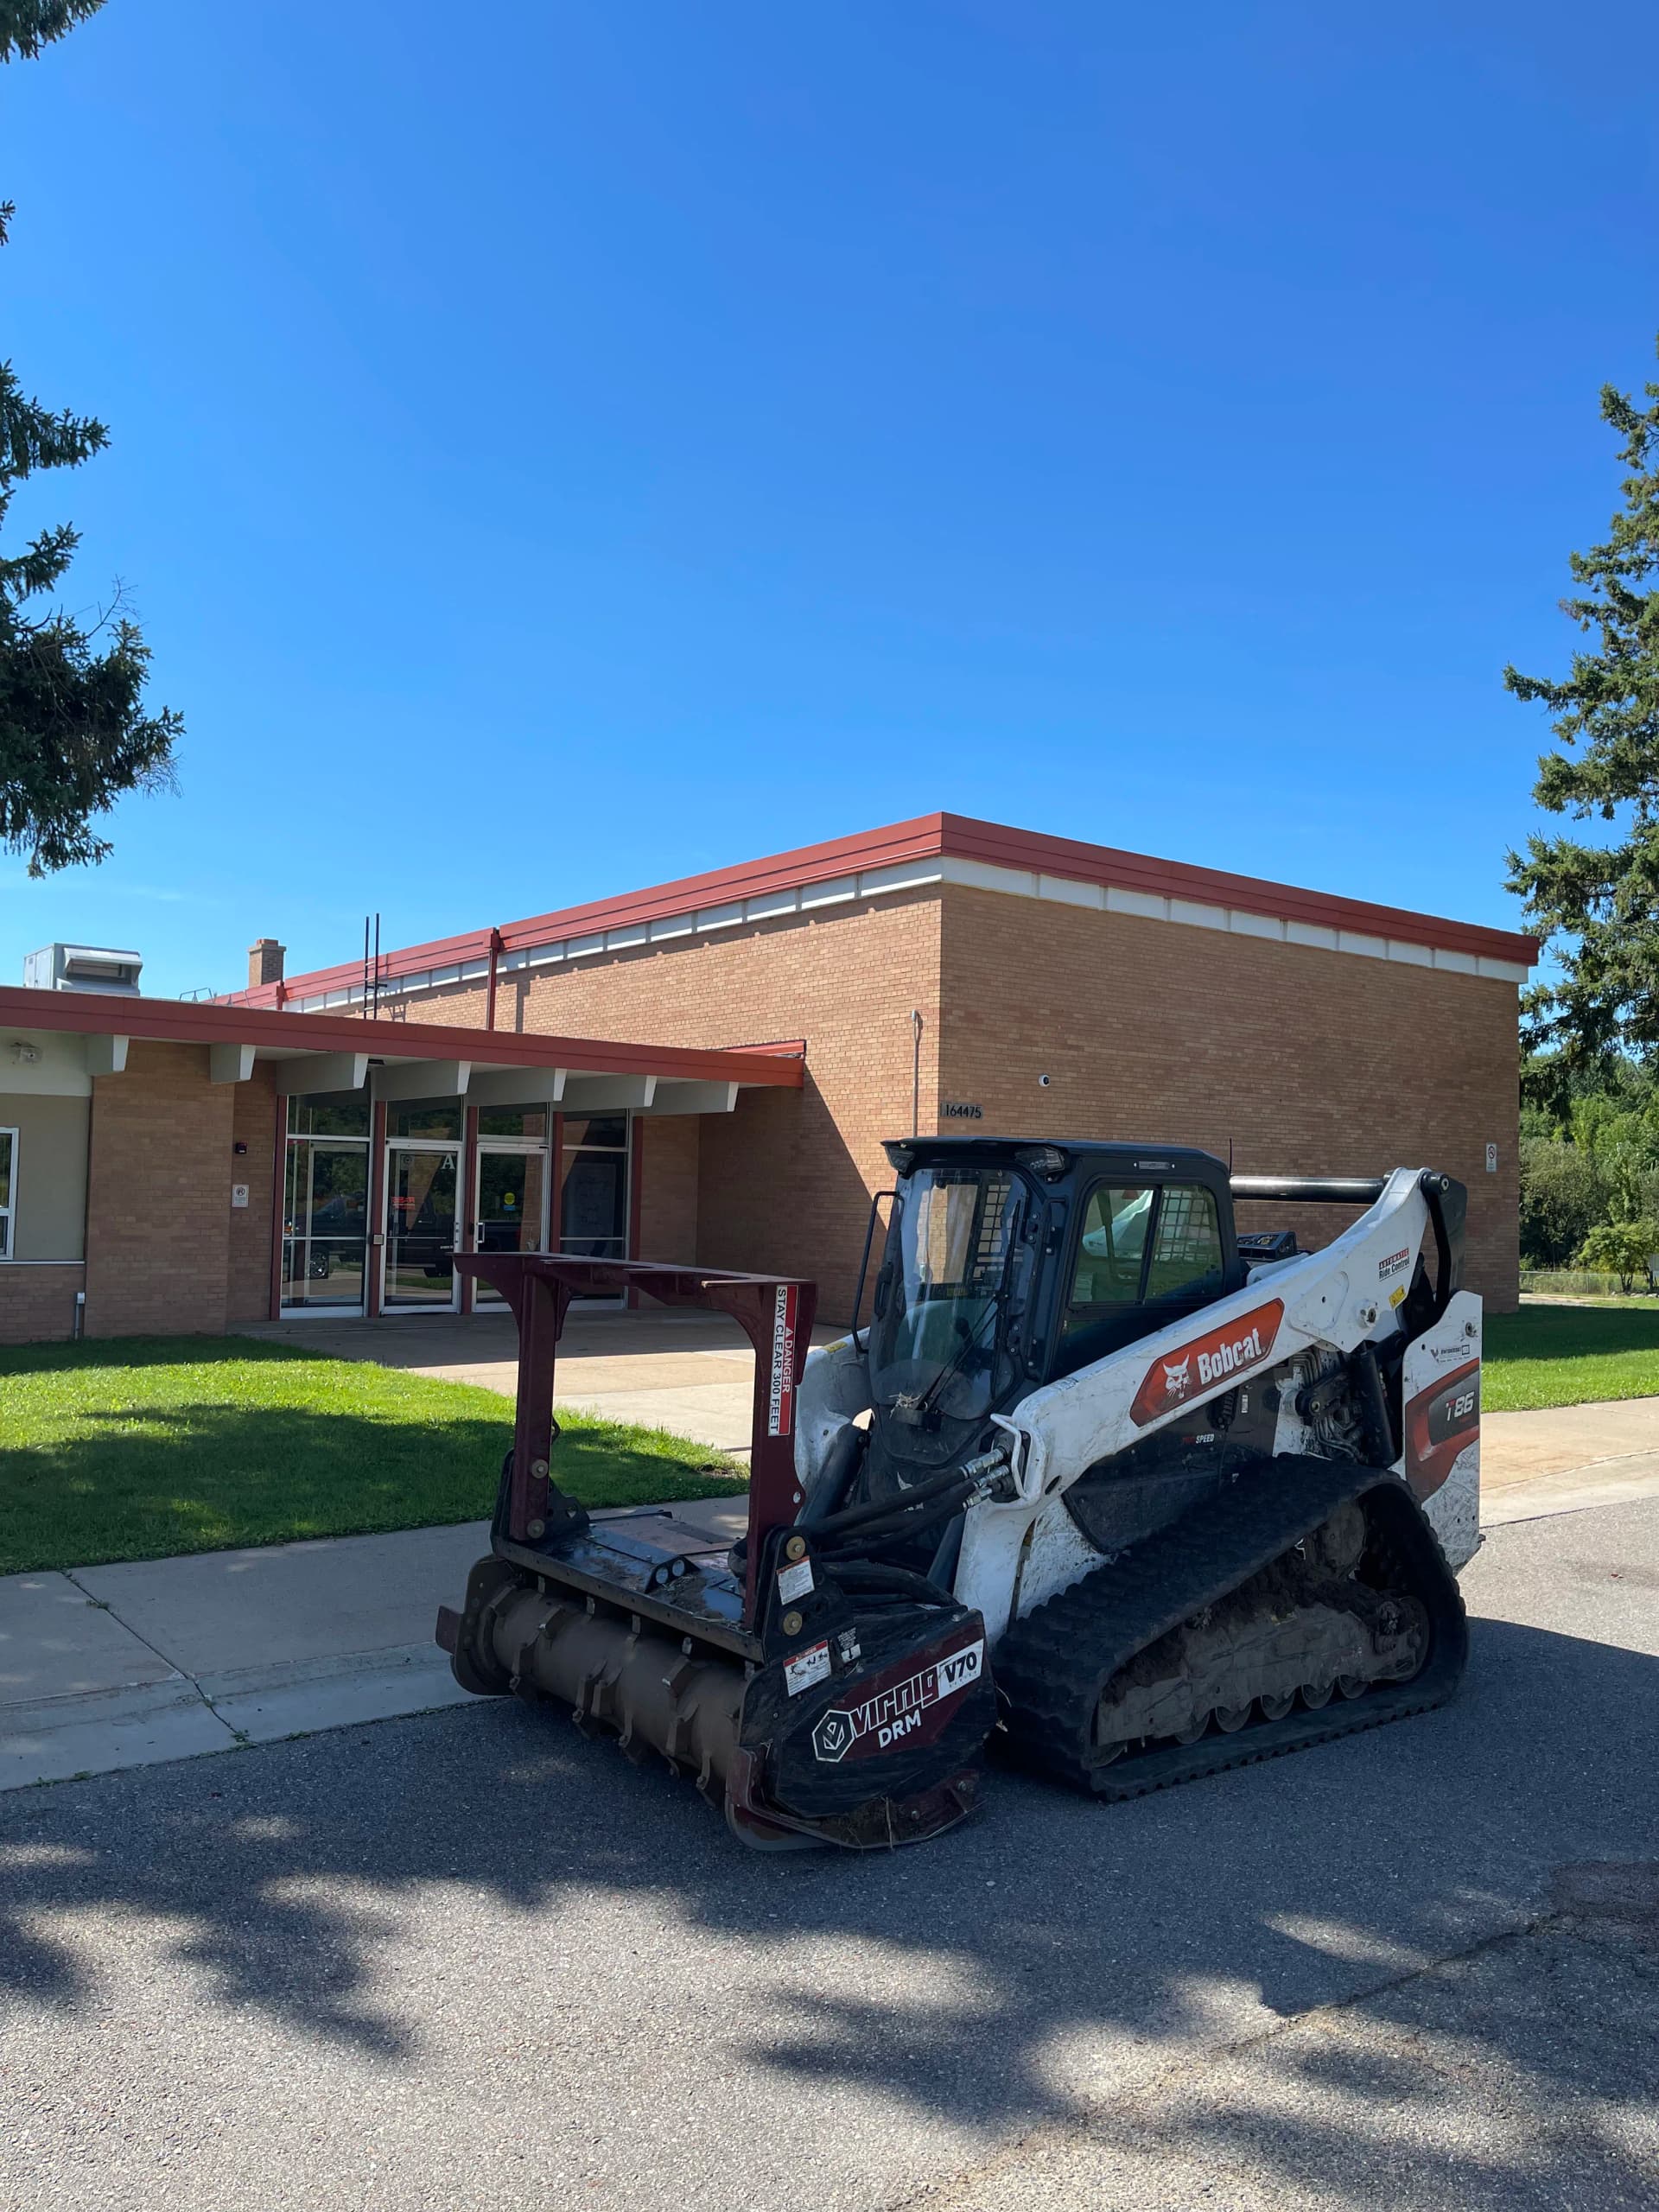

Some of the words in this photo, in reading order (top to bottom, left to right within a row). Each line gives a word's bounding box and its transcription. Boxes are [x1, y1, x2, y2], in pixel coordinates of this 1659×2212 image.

[946, 1104, 982, 1118] 164475
[442, 1154, 455, 1170] A
[1379, 1266, 1390, 1280] Ride
[1391, 1256, 1409, 1273] Control
[776, 1288, 786, 1320] STAY
[773, 1324, 785, 1370] CLEAR
[1197, 1328, 1262, 1385] Bobcat
[782, 1339, 793, 1393] DANGER
[772, 1372, 781, 1394] 300
[770, 1398, 780, 1432] FEET
[1445, 1390, 1475, 1421] T86
[1195, 1433, 1215, 1444] SPEED
[944, 1651, 977, 1683] V70
[878, 1708, 922, 1749] DRM
